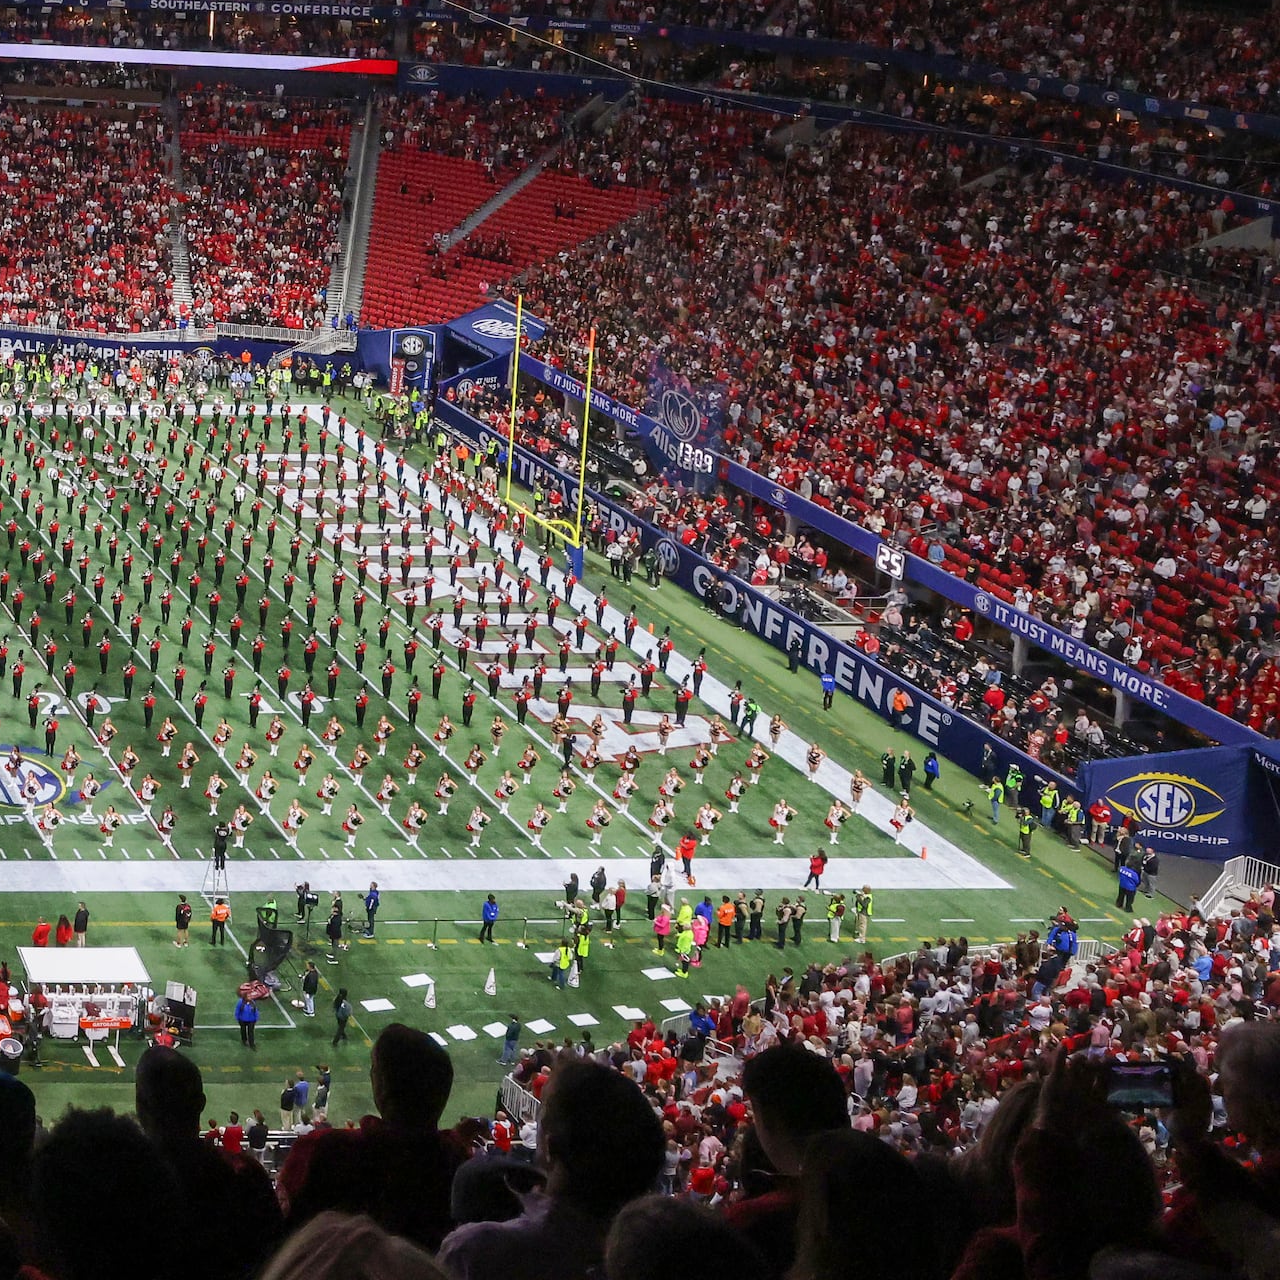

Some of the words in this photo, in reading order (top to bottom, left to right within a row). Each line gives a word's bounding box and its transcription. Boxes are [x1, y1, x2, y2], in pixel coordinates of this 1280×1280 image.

[150, 0, 250, 13] SOUTHEASTERN
[271, 3, 371, 17] CONFERENCE
[403, 337, 422, 354] SEC
[553, 374, 560, 385] IT
[560, 377, 581, 396] JUST
[678, 441, 713, 474] 13:09
[878, 545, 904, 577] 25
[994, 604, 1010, 623] IT
[1009, 611, 1047, 641] JUST
[1051, 634, 1108, 675] MEANS
[1140, 783, 1190, 824] SEC
